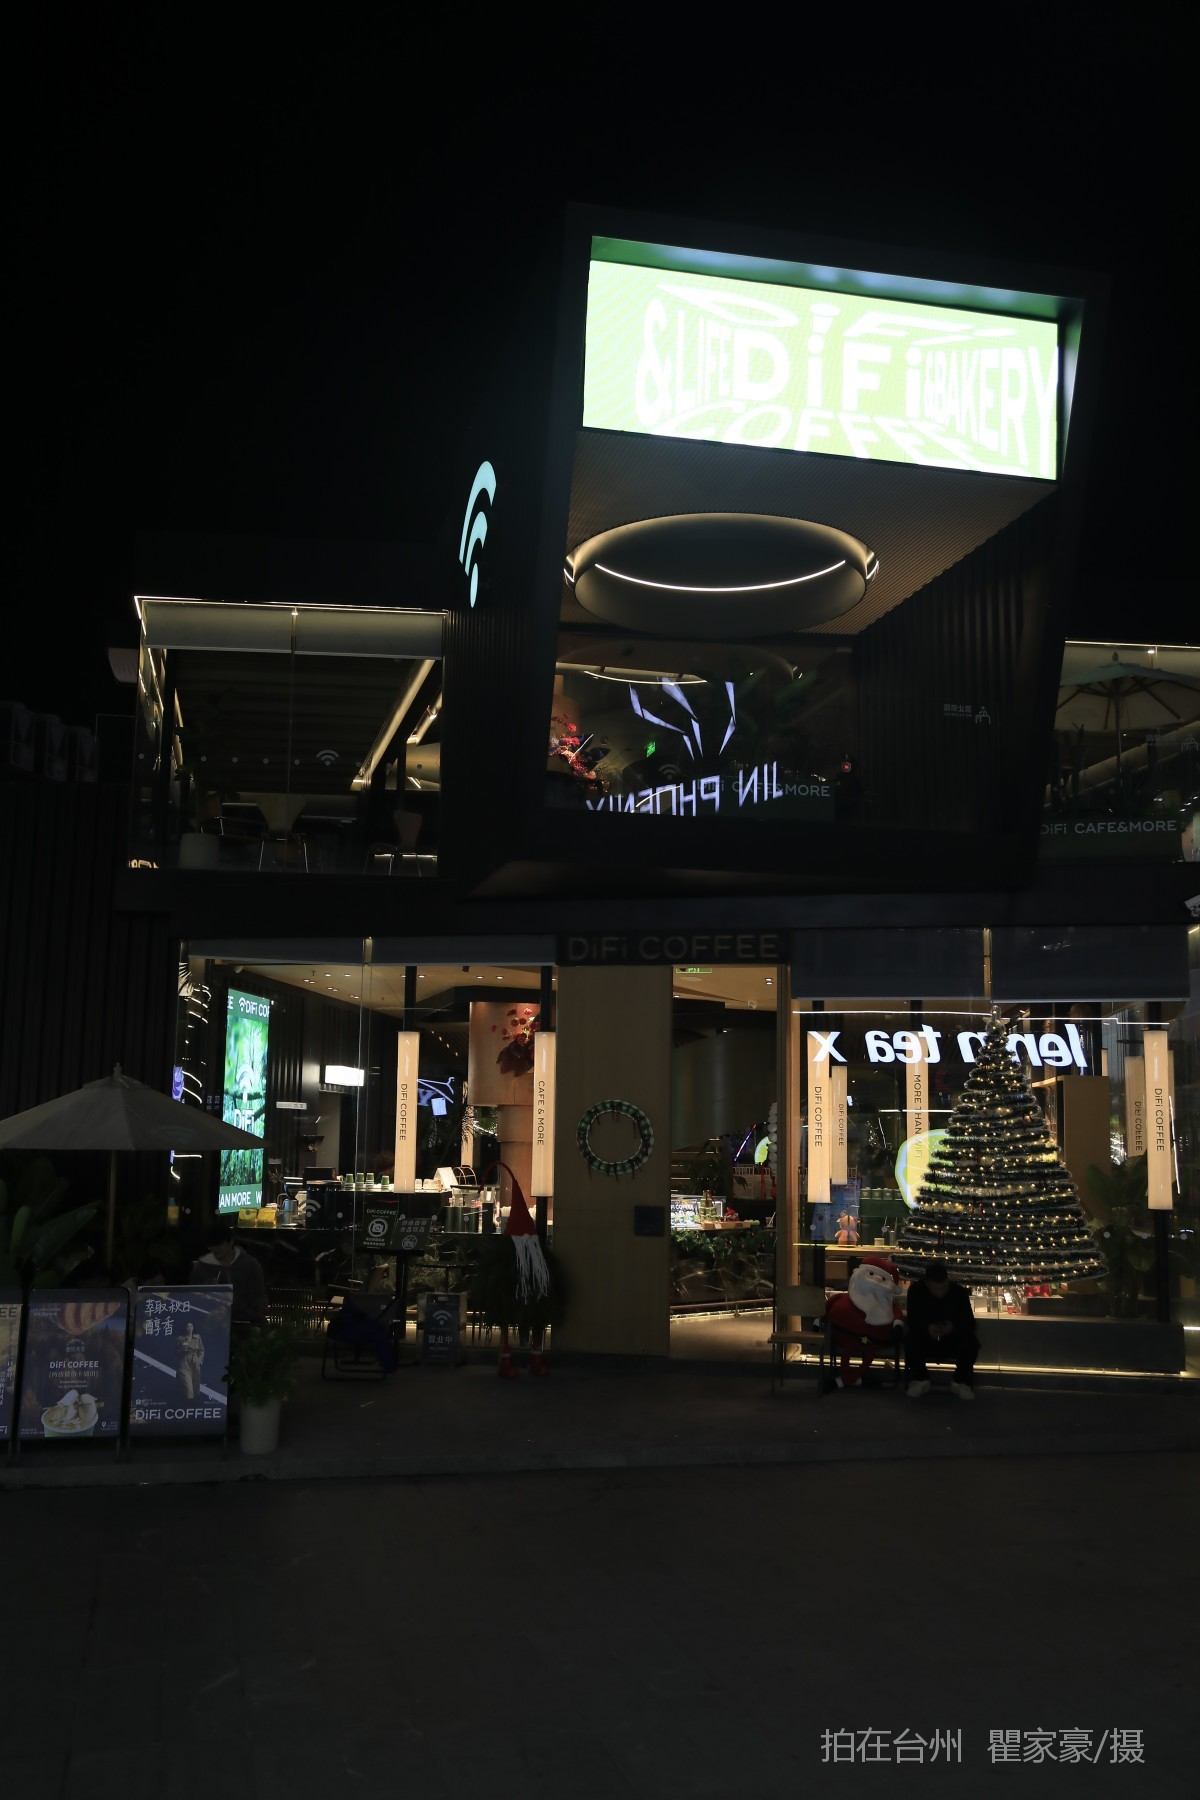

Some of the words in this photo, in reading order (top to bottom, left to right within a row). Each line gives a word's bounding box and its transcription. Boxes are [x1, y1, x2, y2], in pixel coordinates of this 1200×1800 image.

[1074, 819, 1177, 835] CAFE&MORE
[567, 936, 628, 961] DiFi
[639, 934, 780, 961] COFFEE
[814, 1086, 823, 1104] DiFi
[913, 1074, 922, 1104] MORE
[1154, 1088, 1163, 1107] DiFi
[399, 1103, 407, 1141] COFFEE
[537, 1117, 545, 1145] MORE
[814, 1108, 823, 1148] COFFEE
[1155, 1109, 1165, 1151] COFFEE
[231, 1191, 251, 1207] MORE
[145, 1316, 175, 1336] 醇香
[67, 1360, 99, 1369] COFFEE
[135, 1409, 161, 1420] DiFi
[164, 1407, 222, 1420] COFFEE
